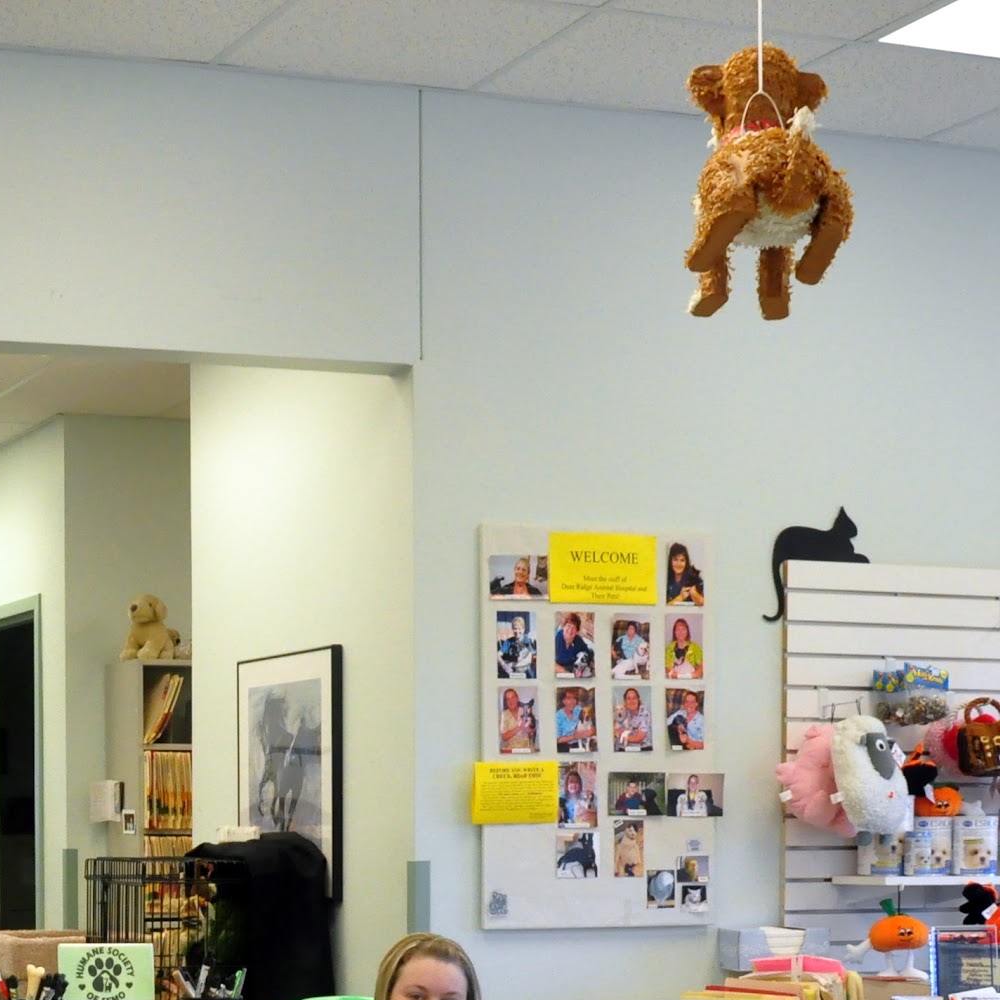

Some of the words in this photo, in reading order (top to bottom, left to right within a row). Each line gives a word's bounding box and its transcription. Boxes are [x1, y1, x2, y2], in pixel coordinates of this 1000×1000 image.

[570, 551, 639, 565] WELCOME
[76, 947, 104, 978] HUMANE
[107, 947, 134, 976] SOCIETY
